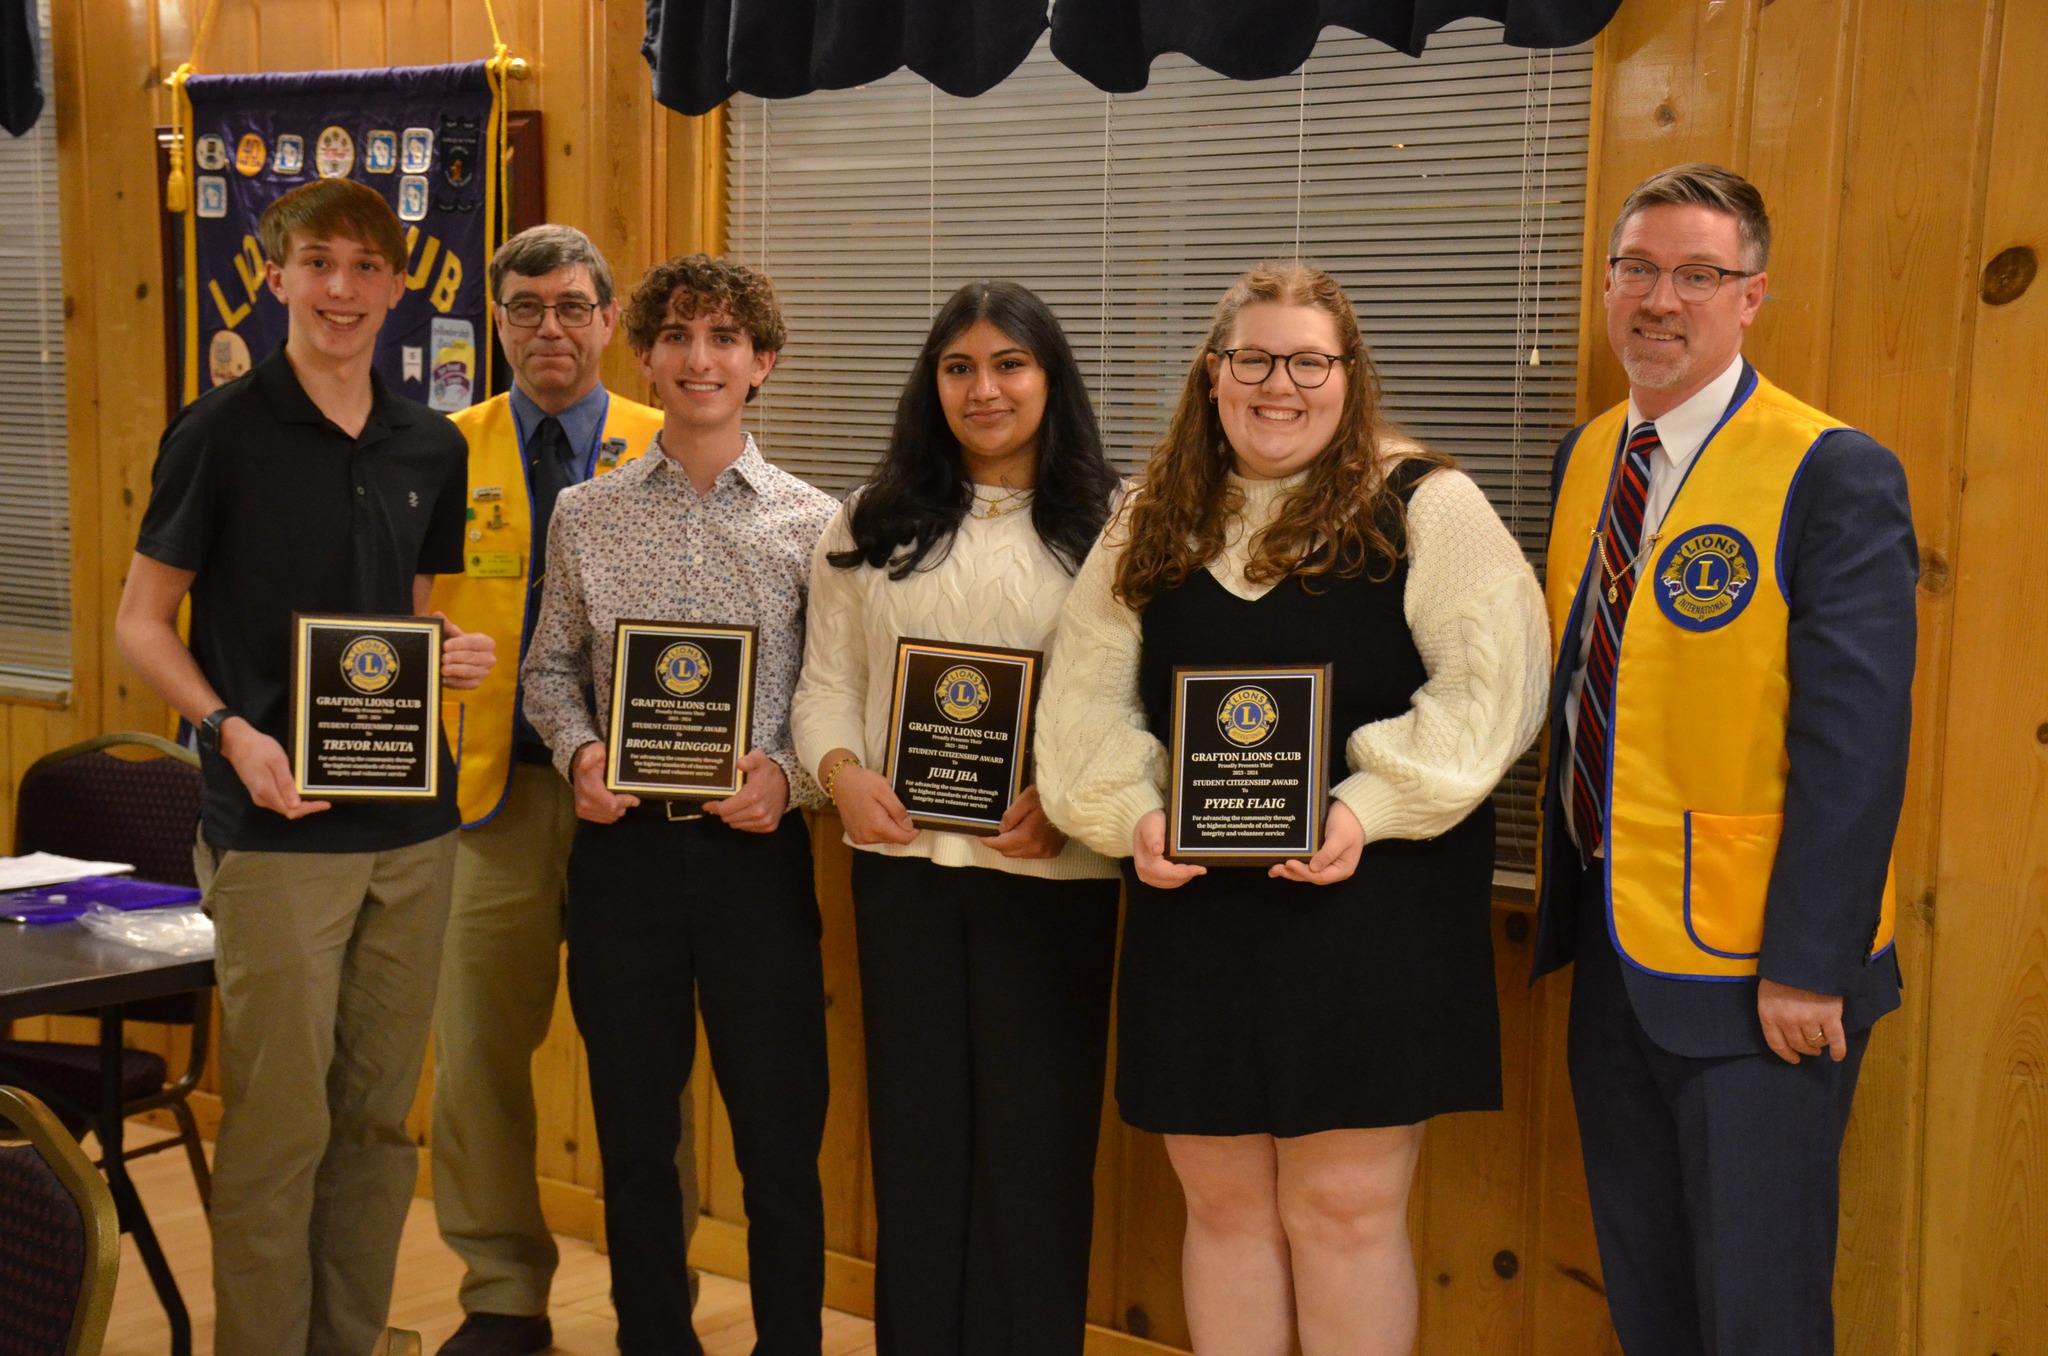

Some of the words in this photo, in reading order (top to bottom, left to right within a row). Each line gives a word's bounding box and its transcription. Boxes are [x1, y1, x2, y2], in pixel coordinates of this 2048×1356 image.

[1685, 536, 1737, 555] LIONS
[1695, 561, 1719, 590] L
[1678, 597, 1729, 615] INTERNATIONAL
[670, 647, 701, 658] LIONS
[364, 655, 379, 674] L
[677, 660, 691, 677] L
[950, 670, 980, 683] LIONS
[956, 684, 970, 703] L
[1232, 691, 1265, 703] LIONS
[316, 696, 363, 706] GRAFTON
[365, 698, 394, 707] LIONS
[396, 699, 421, 708] CLUB
[631, 698, 675, 708] GRAFTON
[677, 701, 704, 710] LIONS
[706, 702, 730, 711] CLUB
[1241, 706, 1256, 725] L
[909, 722, 952, 734] GRAFTON
[954, 727, 982, 737] LIONS
[984, 731, 1008, 741] CLUB
[323, 739, 371, 750] TREVOR
[372, 741, 414, 752] NAUTA
[626, 739, 672, 749] BROGAN
[673, 741, 731, 752] RINGGOLD
[908, 747, 938, 756] STUDENT
[939, 751, 979, 760] CITIZENSHIP
[980, 756, 1004, 764] AWARD
[1192, 752, 1240, 761] GRAFTON
[1242, 752, 1272, 761] LIONS
[1274, 752, 1301, 760] CLUB
[927, 767, 955, 779] JUHI
[955, 770, 978, 782] JHA
[915, 781, 940, 790] advancing
[949, 786, 978, 794] community
[945, 799, 969, 807] volunteer
[1204, 799, 1244, 809] PYPER
[1246, 798, 1285, 809] FLAIG
